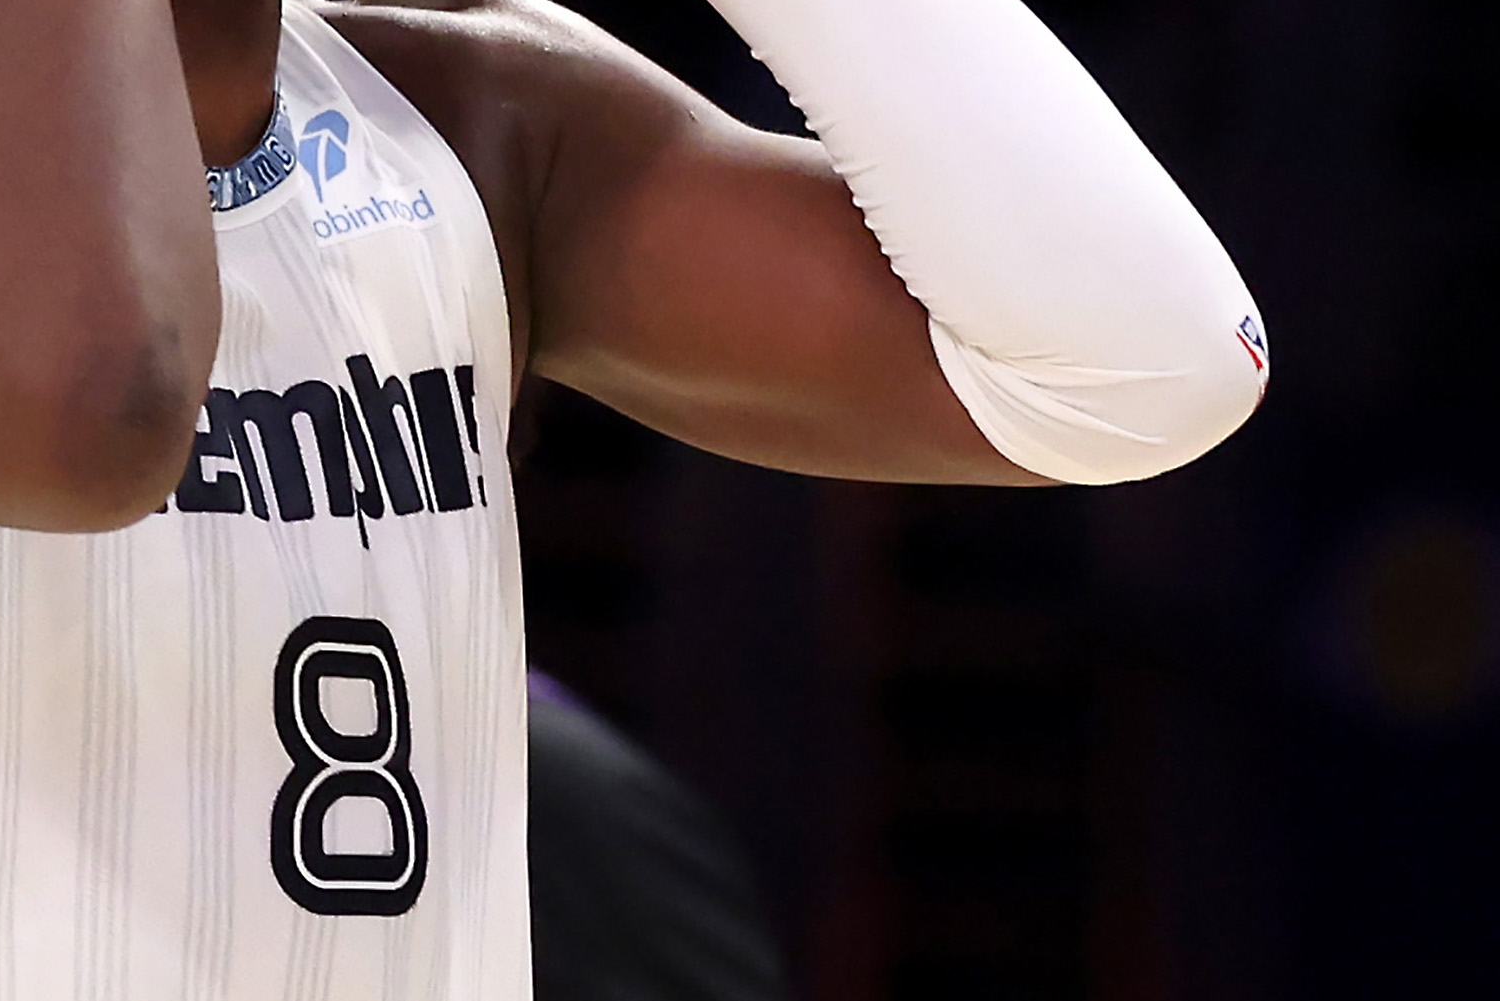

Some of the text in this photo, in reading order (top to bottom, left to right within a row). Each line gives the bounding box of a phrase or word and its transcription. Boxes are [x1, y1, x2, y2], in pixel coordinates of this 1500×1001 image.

[312, 189, 435, 239] obinhod
[156, 353, 488, 550] emphi
[270, 615, 429, 917] 8
